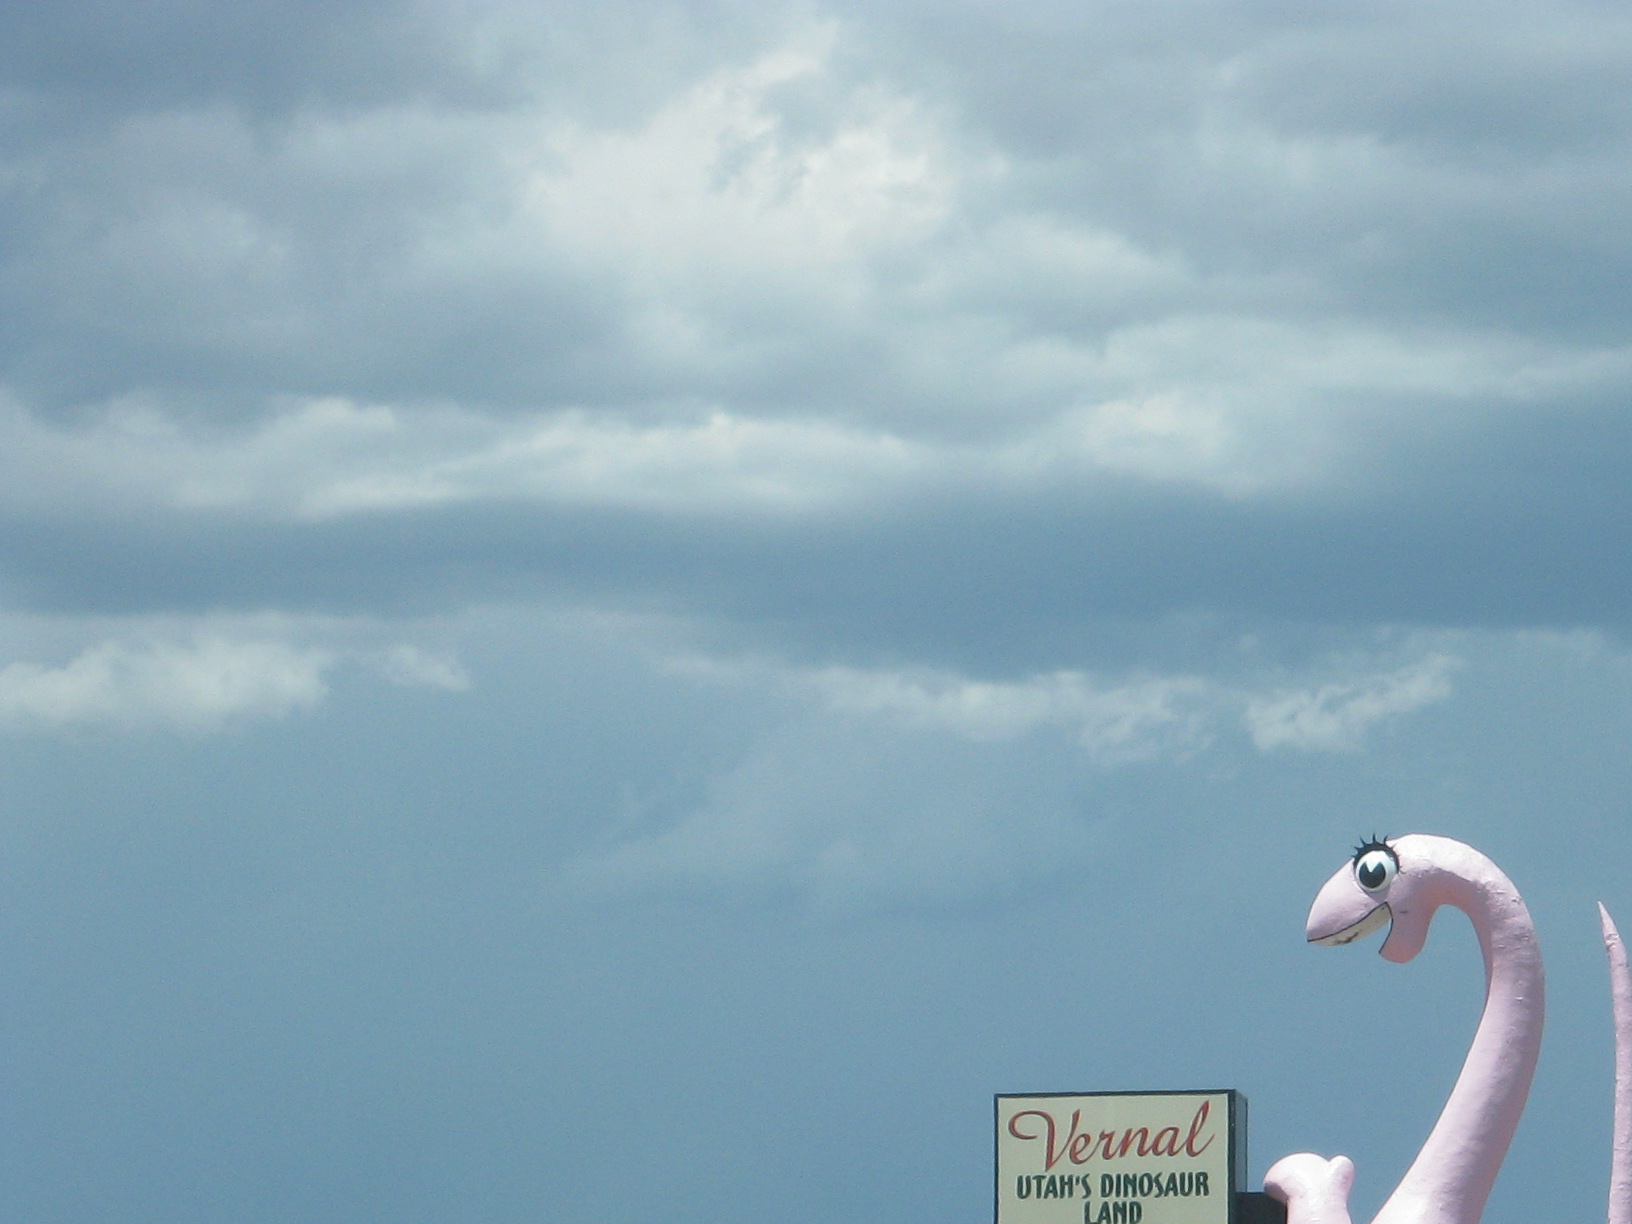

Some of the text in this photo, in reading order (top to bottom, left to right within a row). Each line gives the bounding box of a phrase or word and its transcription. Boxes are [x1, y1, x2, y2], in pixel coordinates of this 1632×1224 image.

[1008, 1099, 1216, 1173] Vernal
[1016, 1171, 1211, 1200] UTAH'S DINOSAUR
